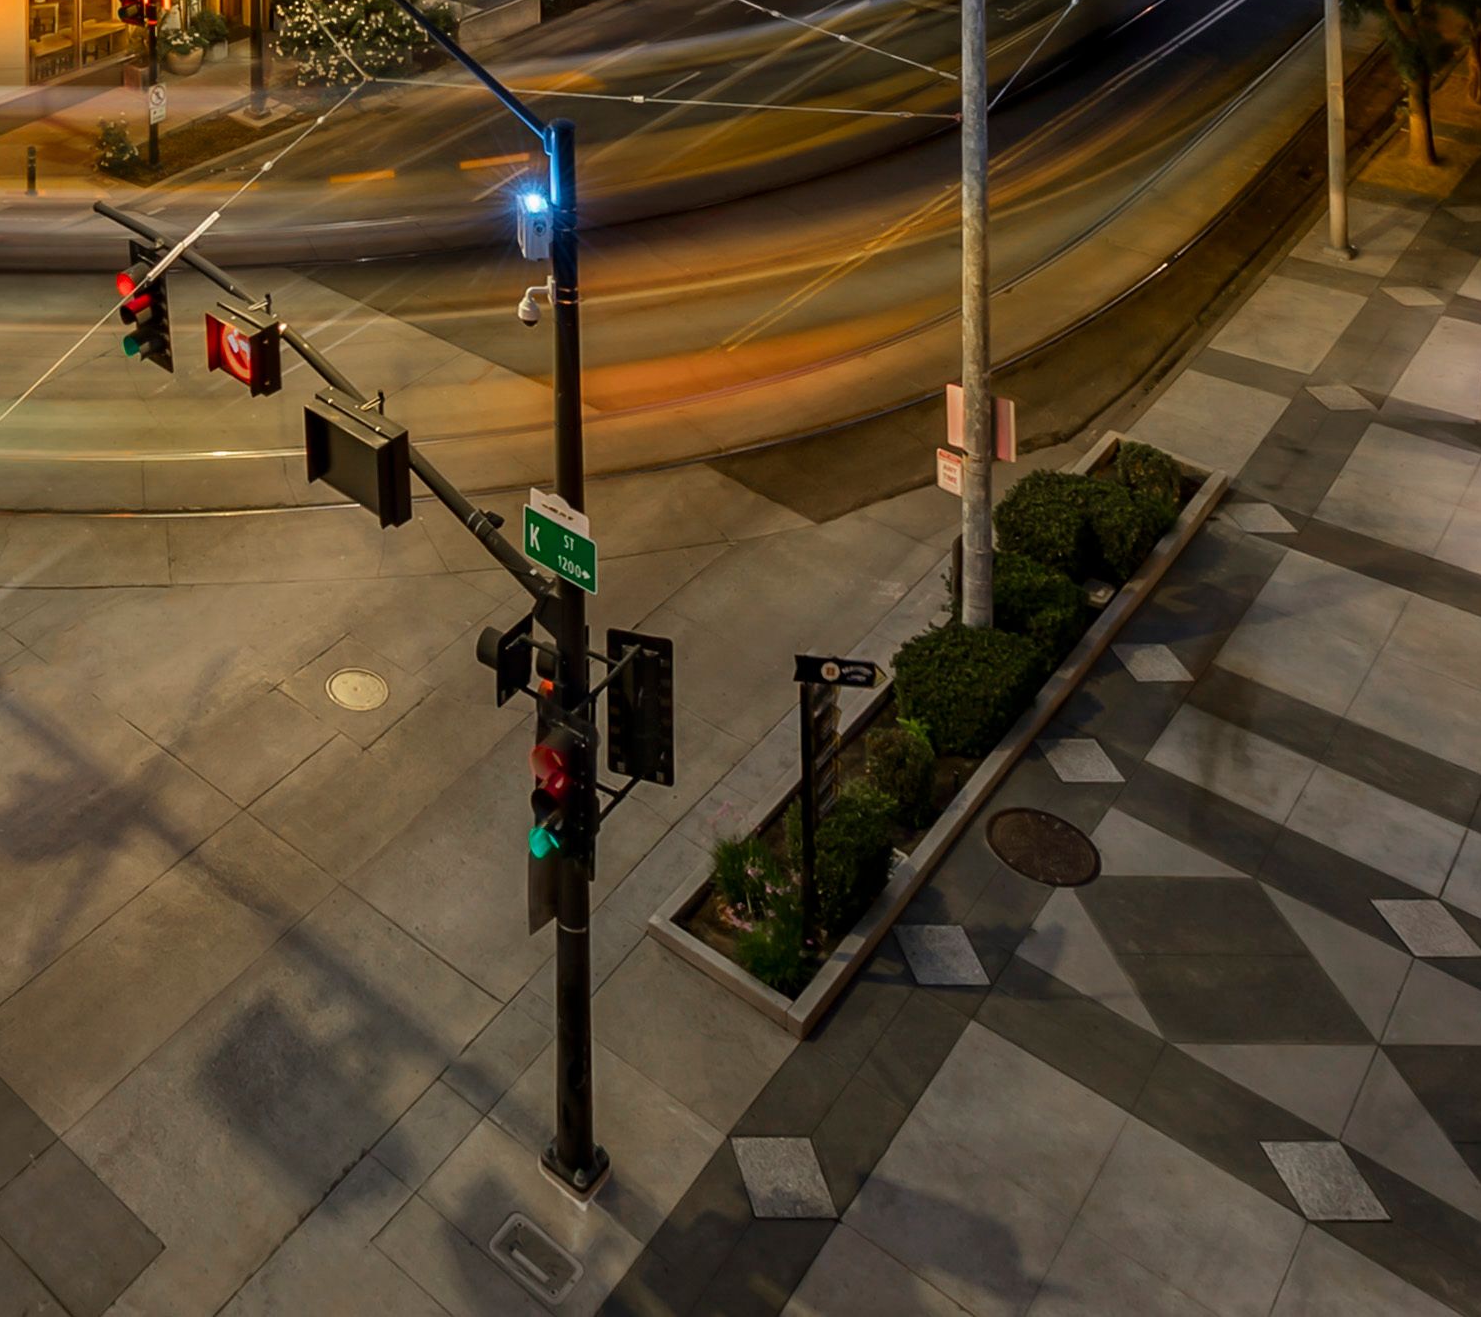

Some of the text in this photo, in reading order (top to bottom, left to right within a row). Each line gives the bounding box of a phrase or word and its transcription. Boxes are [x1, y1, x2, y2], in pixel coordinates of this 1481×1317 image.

[530, 523, 575, 552] K ST
[558, 555, 582, 578] 1200
